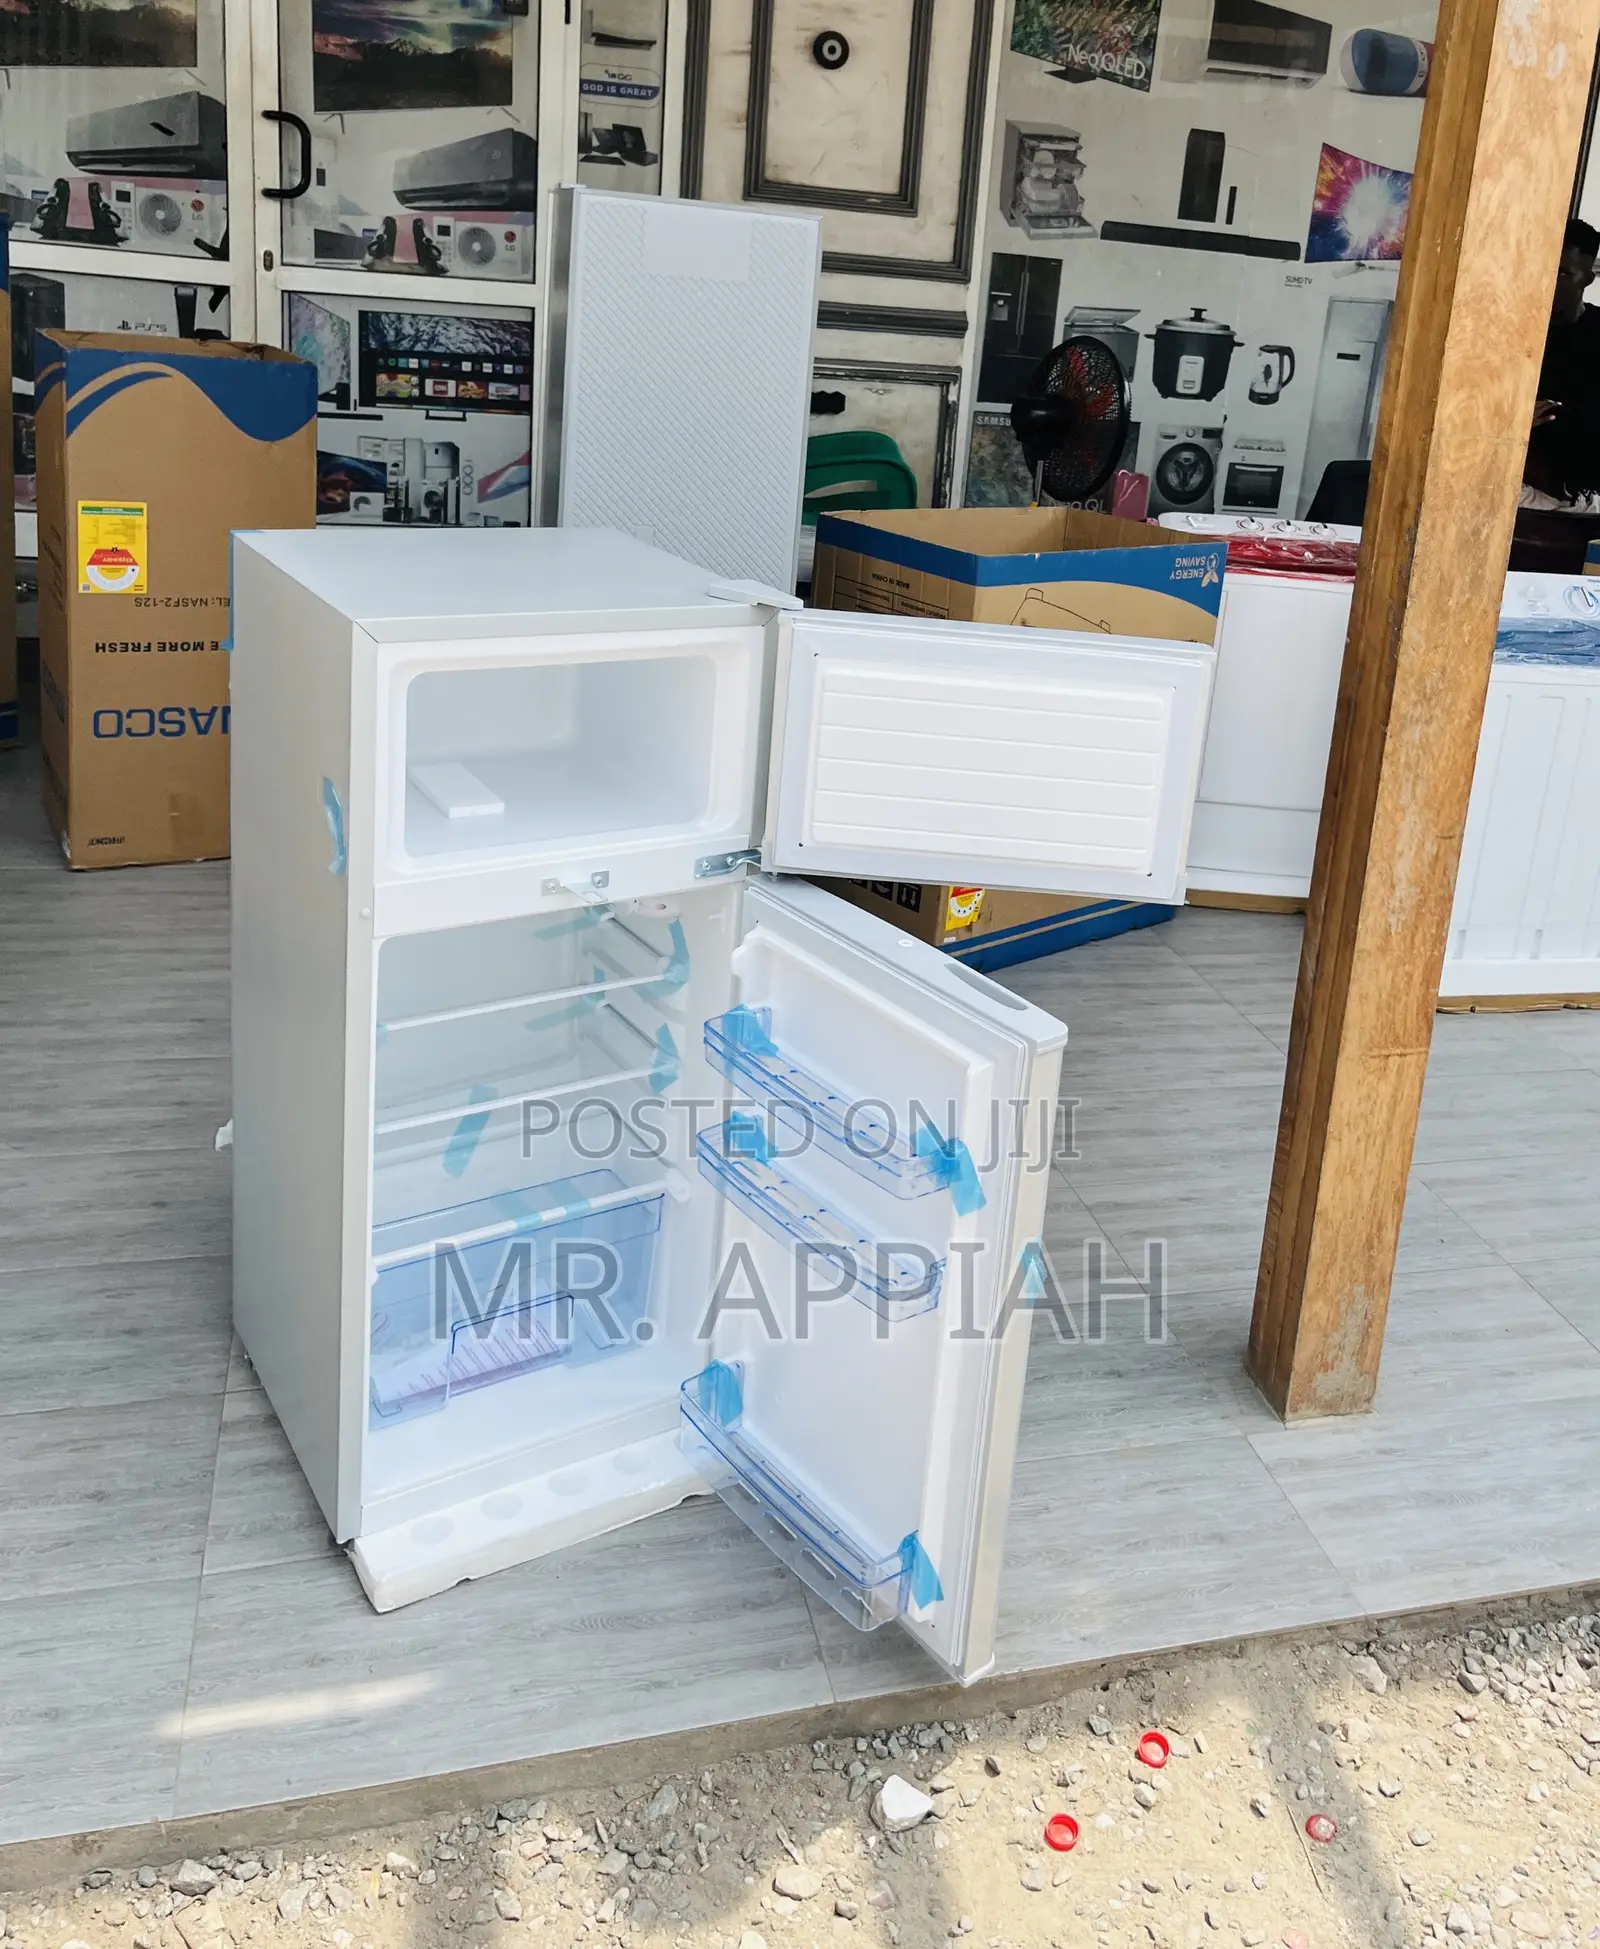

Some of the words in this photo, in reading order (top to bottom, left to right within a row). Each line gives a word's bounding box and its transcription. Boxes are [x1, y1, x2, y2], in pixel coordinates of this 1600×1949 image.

[582, 83, 603, 92] GOD
[606, 85, 617, 93] IS
[620, 86, 654, 97] GREAT
[976, 415, 1012, 426] SAMSU
[1175, 556, 1206, 567] SAVING
[1169, 568, 1204, 580] ENERGY
[134, 597, 209, 608] NASF2-12S
[212, 597, 231, 607] EL:
[95, 641, 152, 653] FRESH
[157, 641, 205, 653] MORE
